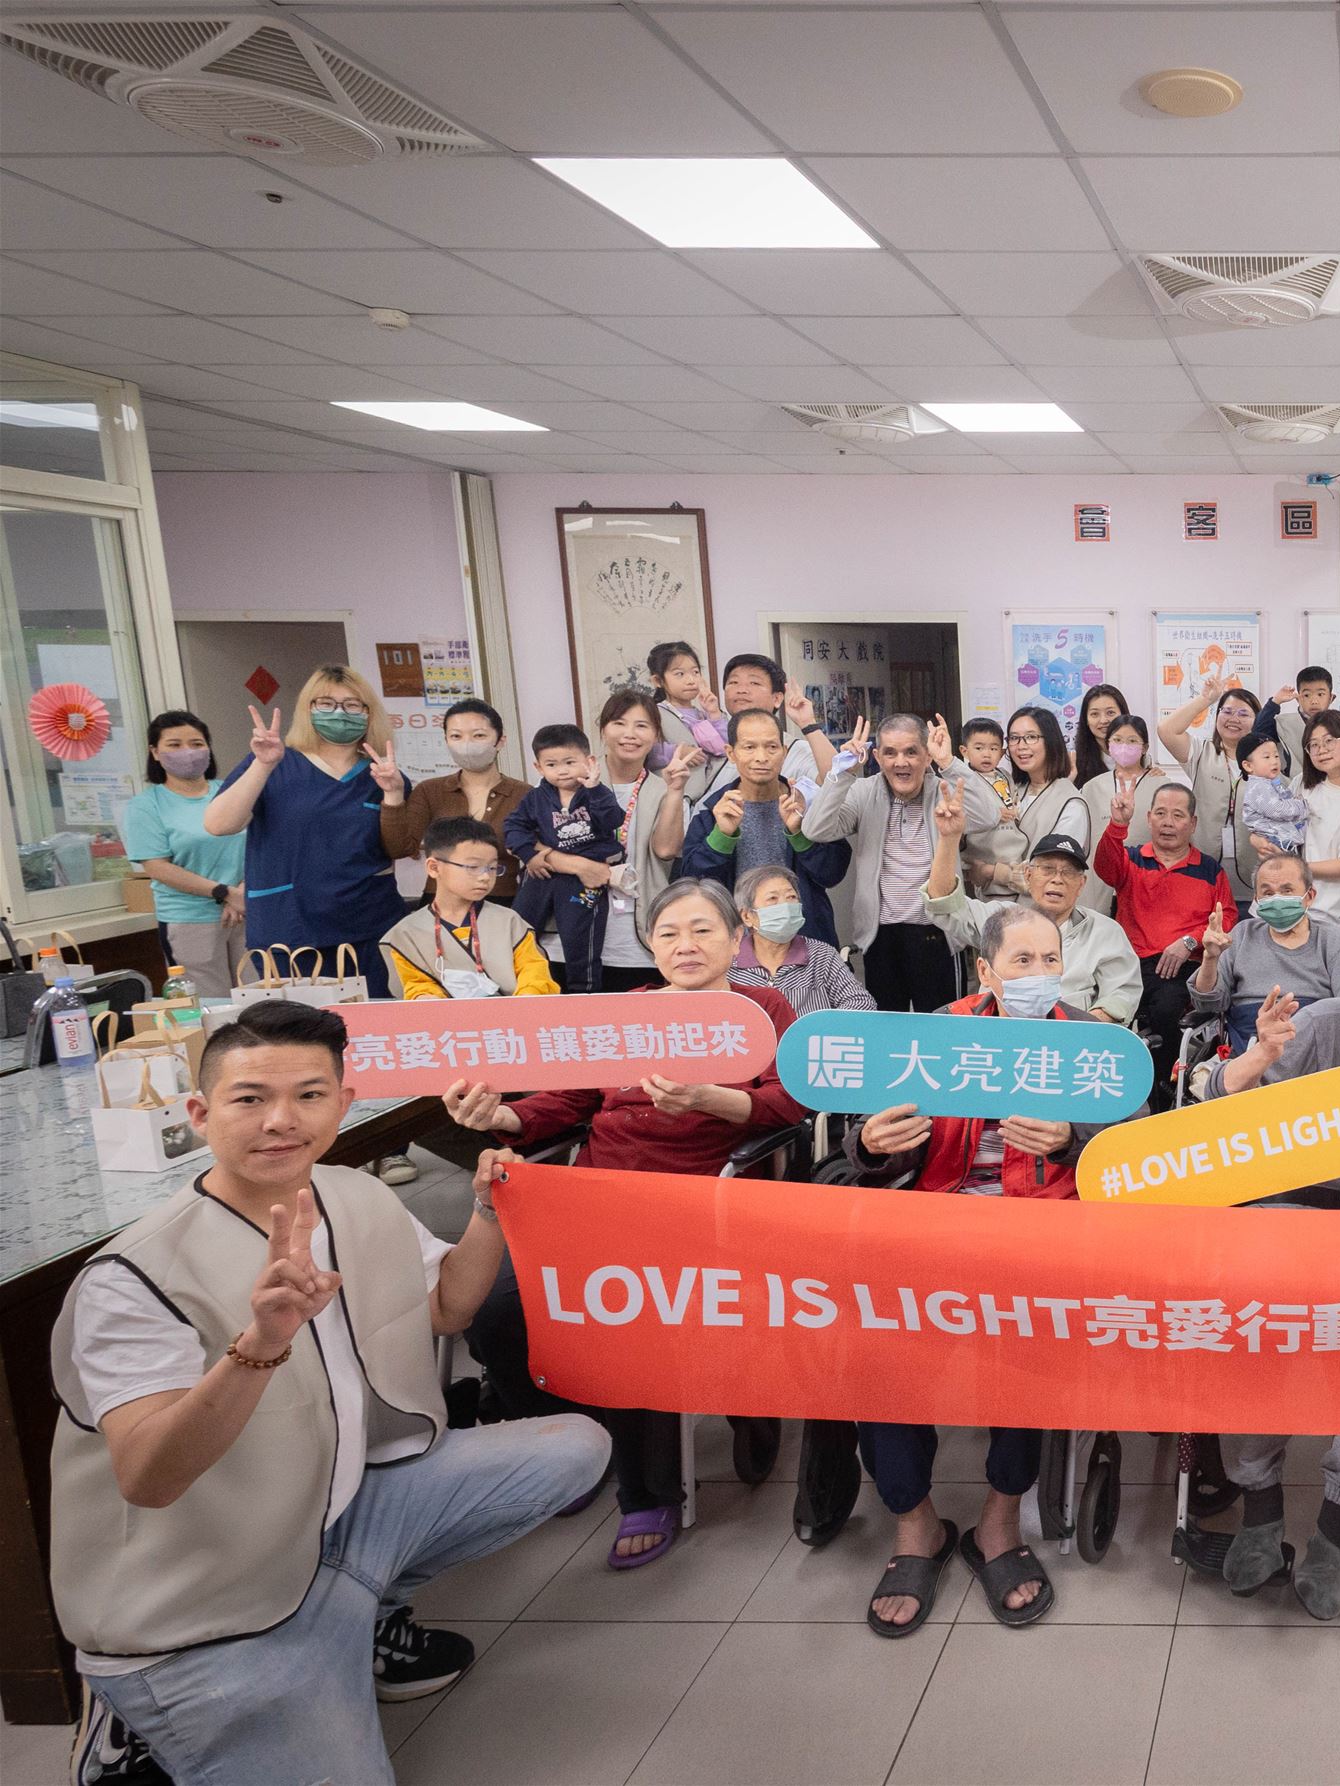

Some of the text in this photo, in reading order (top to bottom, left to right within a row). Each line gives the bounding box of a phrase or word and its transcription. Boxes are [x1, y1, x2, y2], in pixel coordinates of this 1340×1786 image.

[383, 650, 414, 665] 101
[64, 1025, 79, 1050] evian
[535, 1019, 751, 1064] 讓愛動起來
[886, 1040, 1127, 1099] 大亮建築
[1101, 1142, 1214, 1199] #LOVE
[1217, 1132, 1254, 1167] IS
[540, 1265, 742, 1327] LOVE
[764, 1272, 839, 1329] IS
